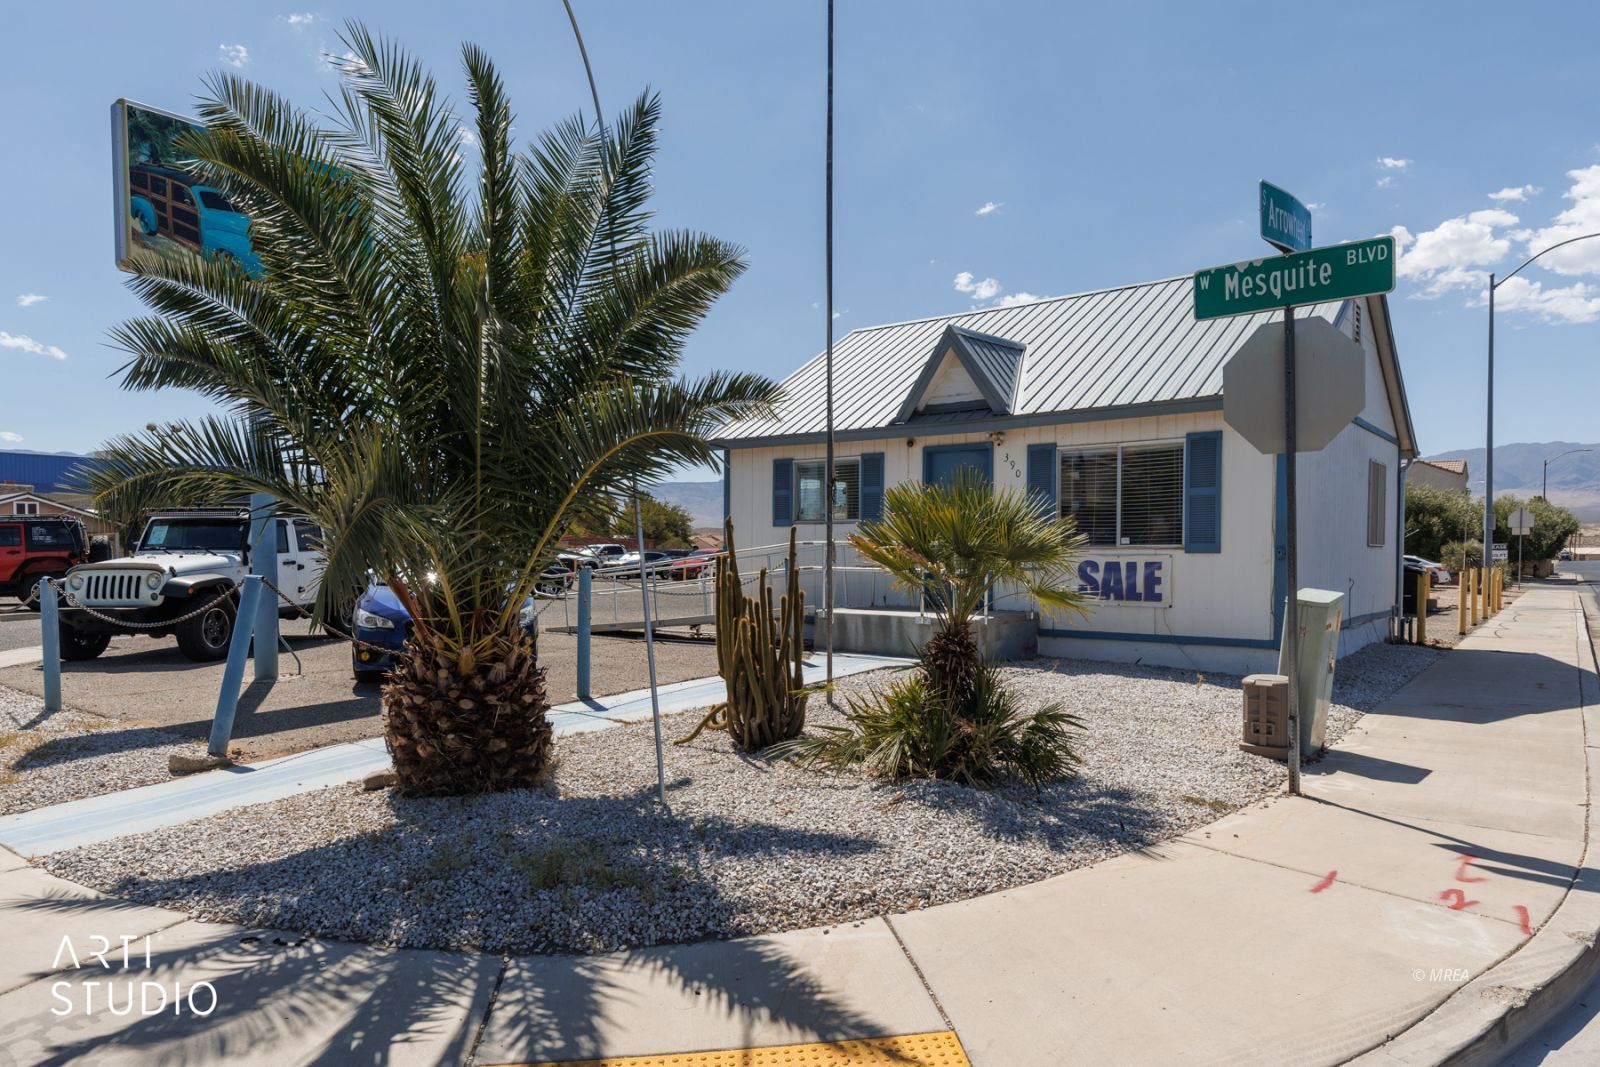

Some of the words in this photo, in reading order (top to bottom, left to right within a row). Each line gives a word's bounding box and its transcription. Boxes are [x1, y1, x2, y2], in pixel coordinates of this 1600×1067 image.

[1262, 190, 1267, 206] S
[1200, 275, 1210, 290] W
[1225, 259, 1332, 300] Mesquite
[1347, 244, 1388, 266] BLVD
[1003, 453, 1022, 478] 390
[1078, 560, 1162, 602] SALE
